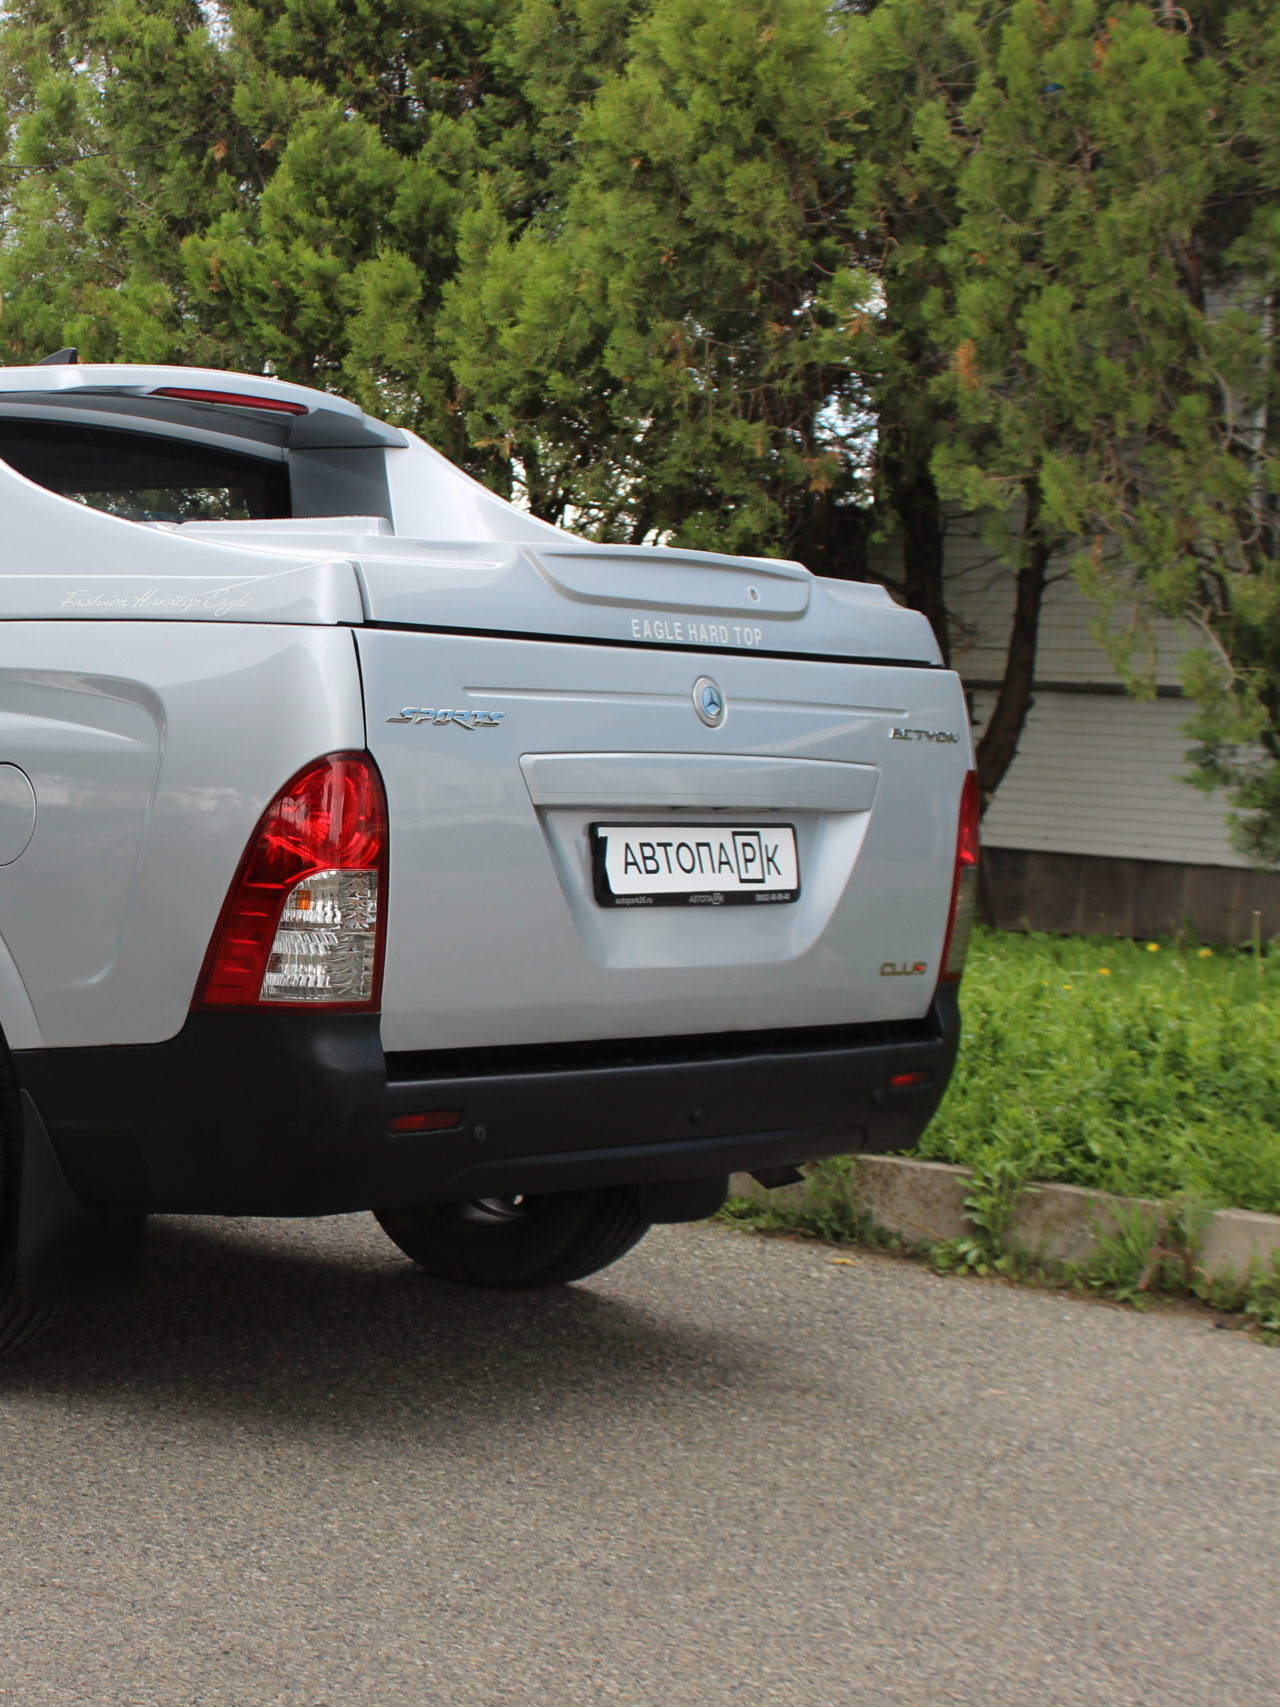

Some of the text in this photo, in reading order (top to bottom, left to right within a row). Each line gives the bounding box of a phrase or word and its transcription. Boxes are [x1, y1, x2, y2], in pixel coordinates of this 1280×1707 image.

[631, 618, 763, 646] EAGLE HARD TOP
[385, 706, 507, 731] SPORTS
[888, 727, 960, 744] ACTYON
[624, 835, 783, 881] АВТОПАРК
